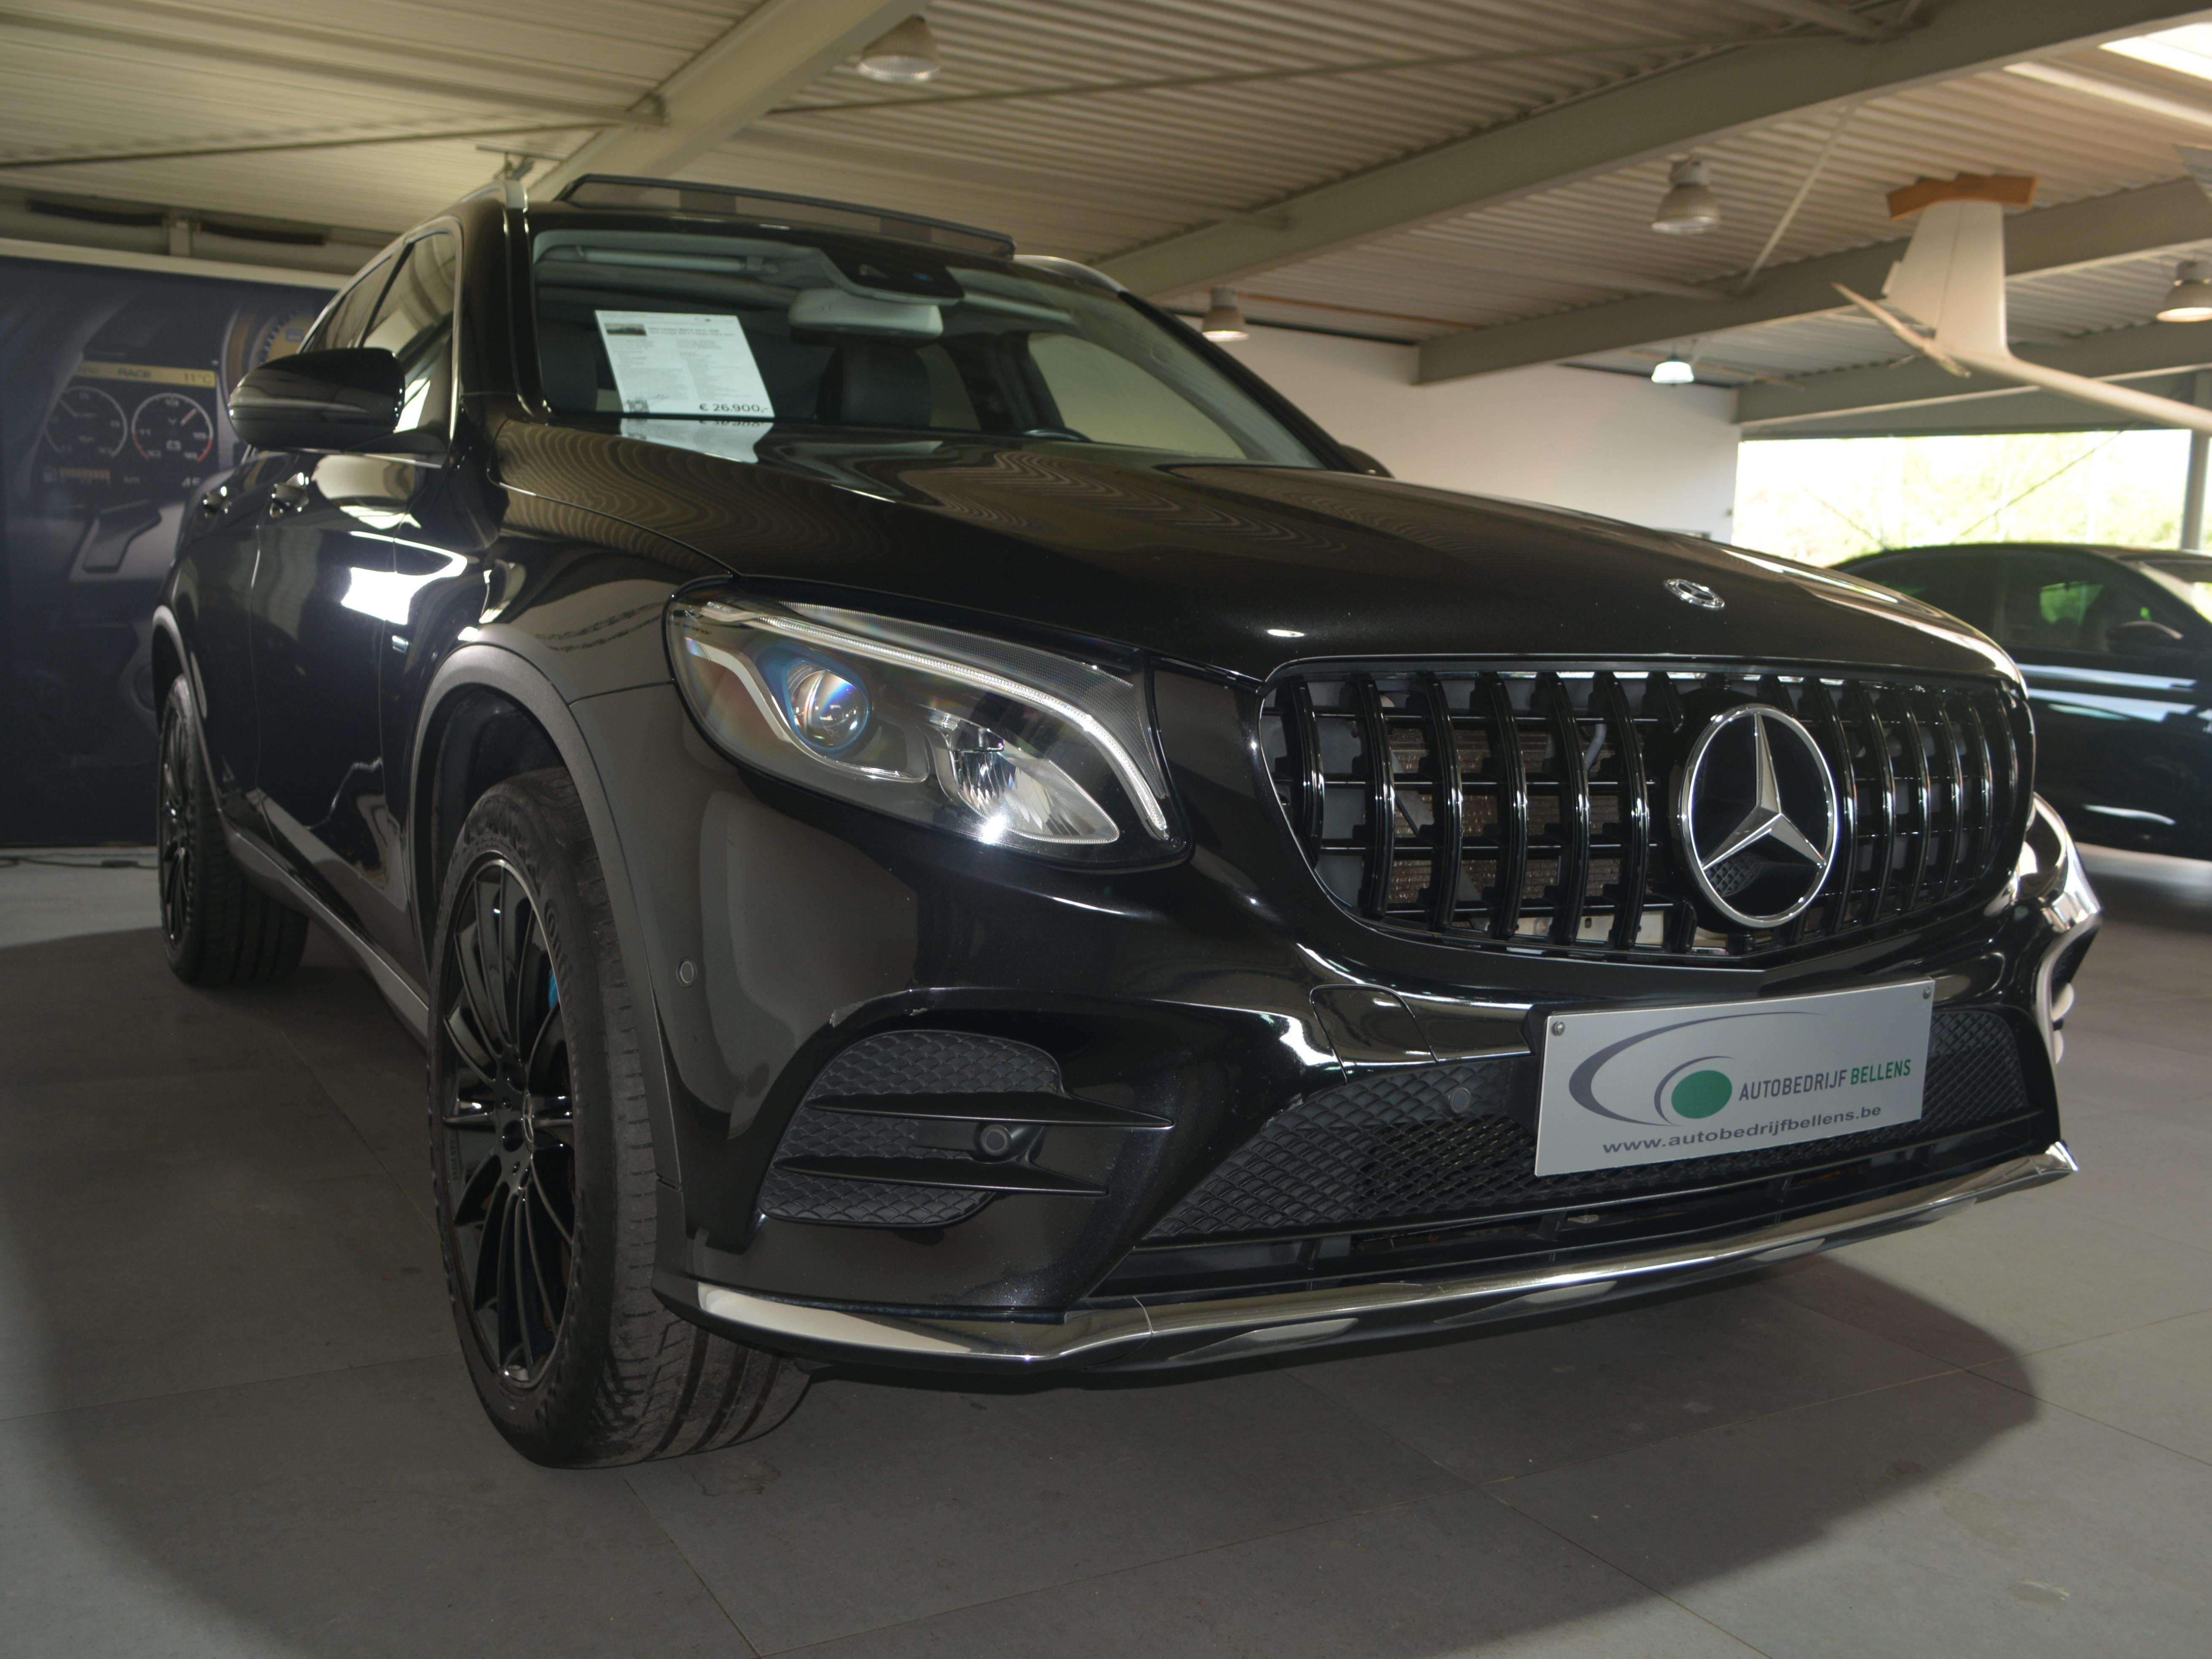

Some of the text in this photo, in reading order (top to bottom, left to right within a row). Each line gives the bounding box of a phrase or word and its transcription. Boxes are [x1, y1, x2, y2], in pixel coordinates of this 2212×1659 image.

[699, 403, 708, 411] €
[1739, 1059, 1911, 1101] AUTOBEDRIJF BELLENS
[1602, 1105, 1881, 1154] www.autobedrijfbellens.be
